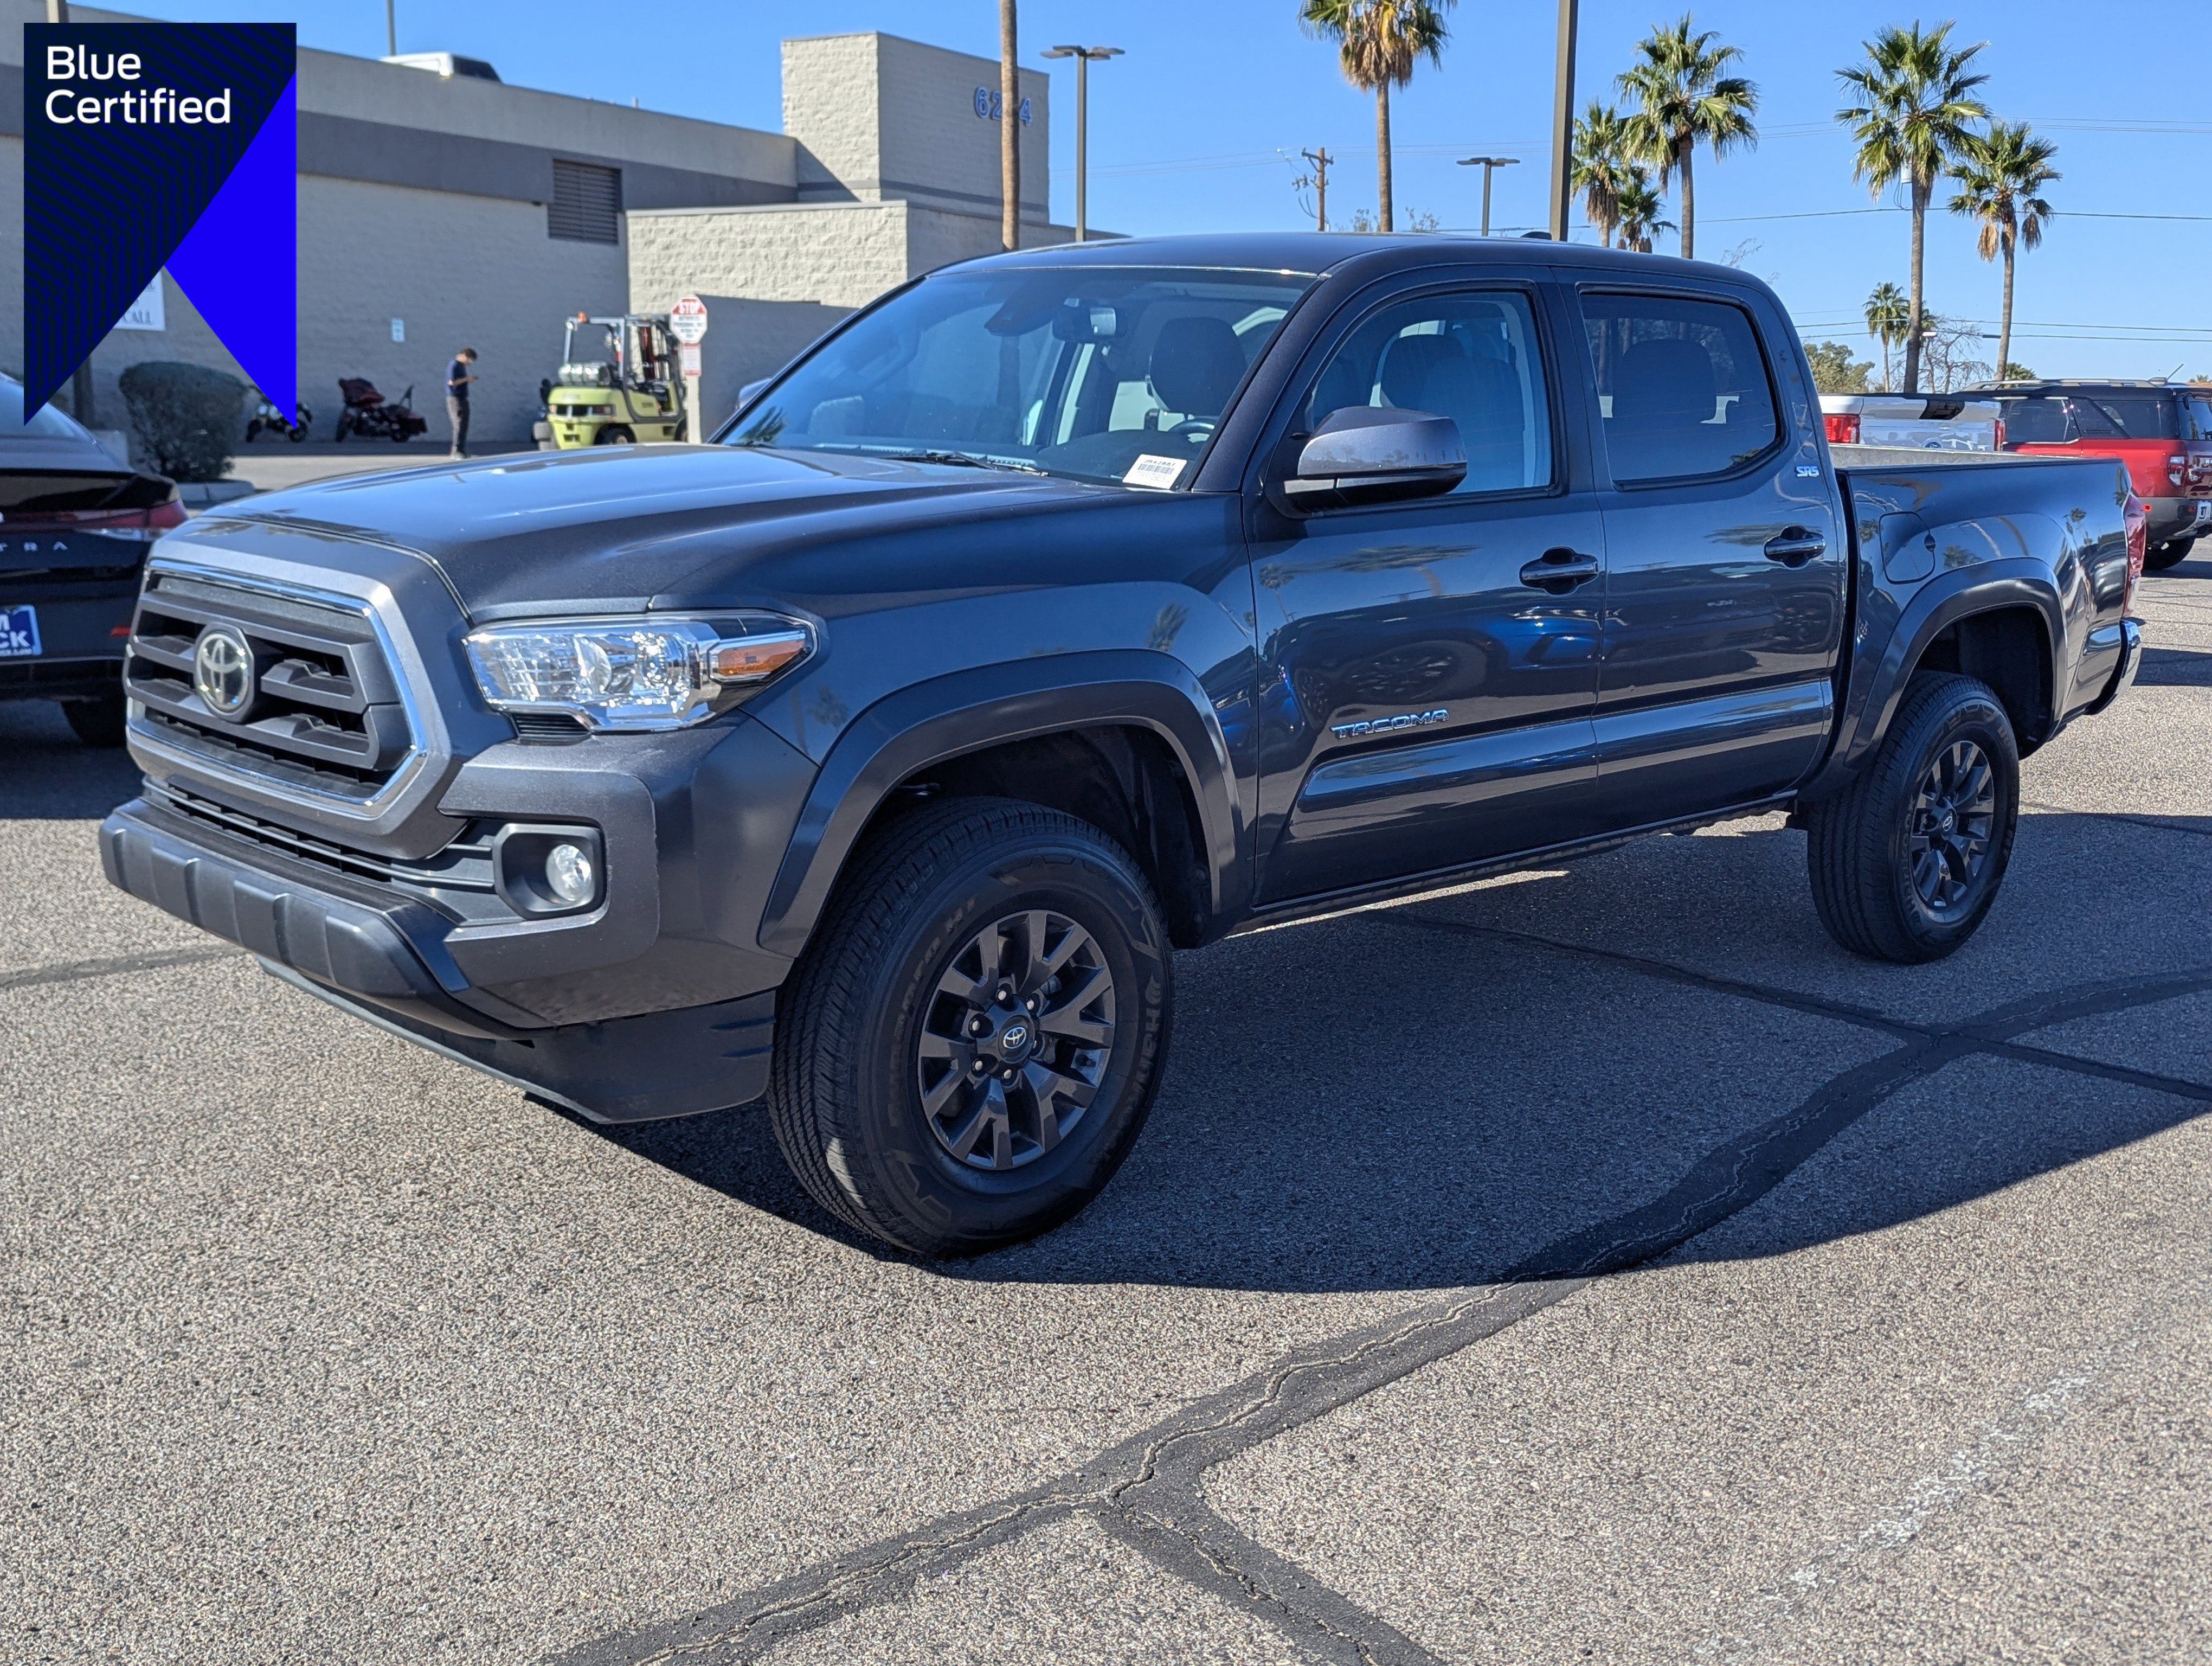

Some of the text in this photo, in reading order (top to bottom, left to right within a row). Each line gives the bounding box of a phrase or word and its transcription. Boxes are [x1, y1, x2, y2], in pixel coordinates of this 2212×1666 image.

[975, 87, 1032, 126] 624
[679, 302, 700, 315] STOP
[1796, 466, 1819, 477] SR5
[1330, 708, 1450, 739] TACOMA
